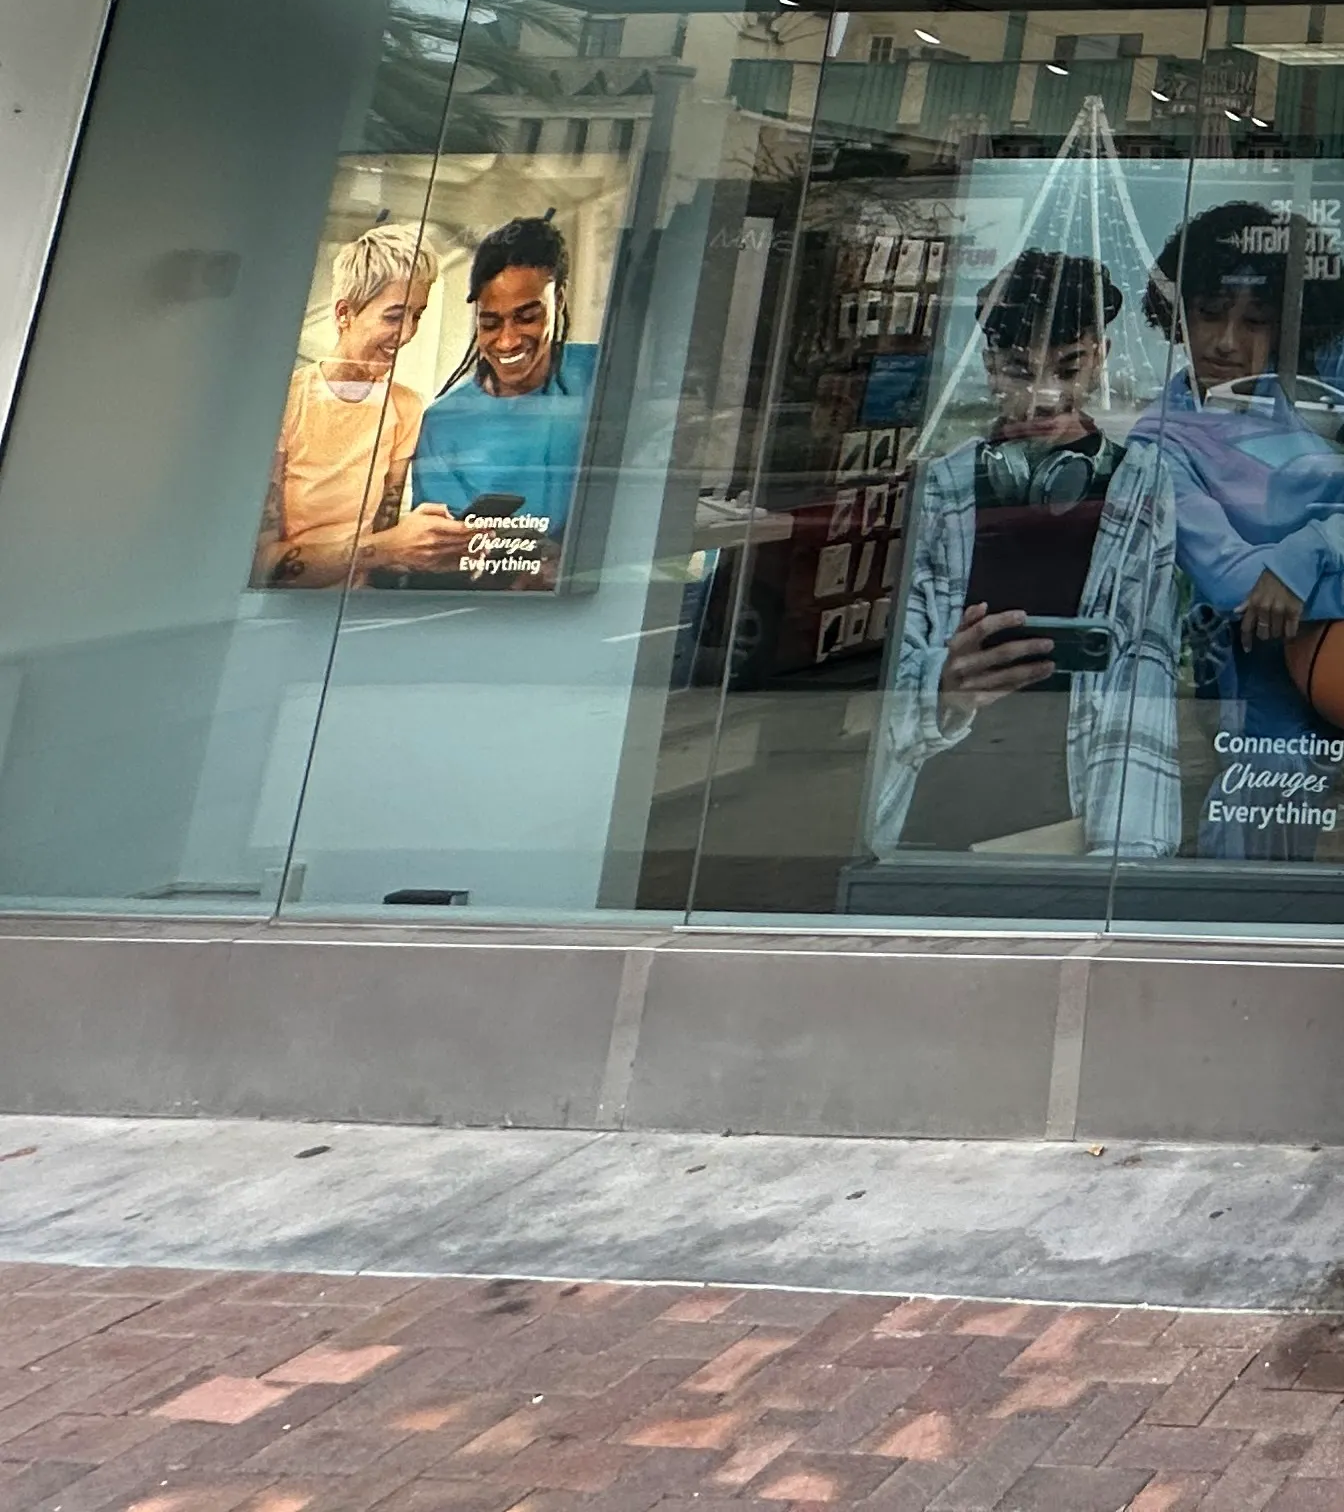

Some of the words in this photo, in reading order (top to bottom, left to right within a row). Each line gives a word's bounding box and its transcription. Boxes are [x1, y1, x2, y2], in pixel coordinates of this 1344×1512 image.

[464, 513, 550, 532] Connecting
[468, 533, 537, 554] Changes
[1213, 731, 1344, 762] Connecting
[1221, 762, 1329, 798] Changes
